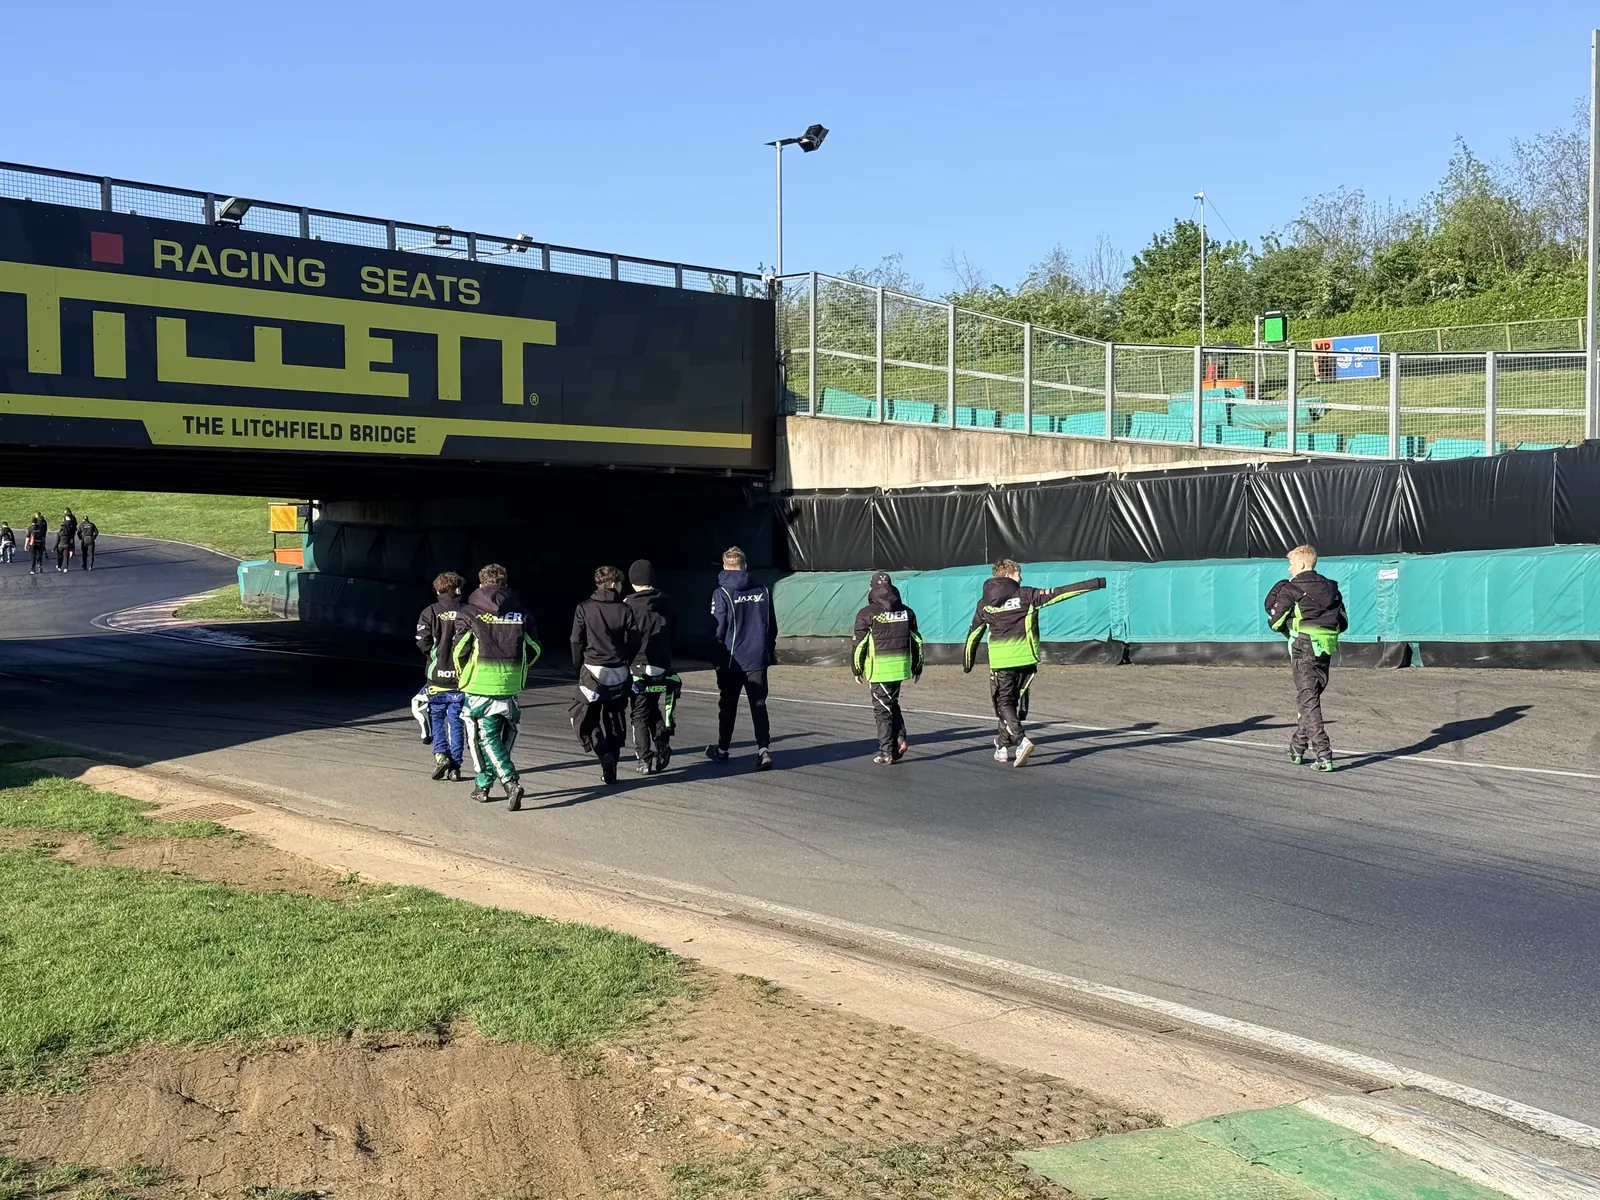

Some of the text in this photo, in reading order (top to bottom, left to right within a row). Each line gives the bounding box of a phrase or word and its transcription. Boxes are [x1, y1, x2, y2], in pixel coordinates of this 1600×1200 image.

[153, 238, 481, 305] RACING SEATS
[0, 260, 556, 405] TILLETT
[182, 415, 416, 444] THE LITCHFIELD BRIDGE
